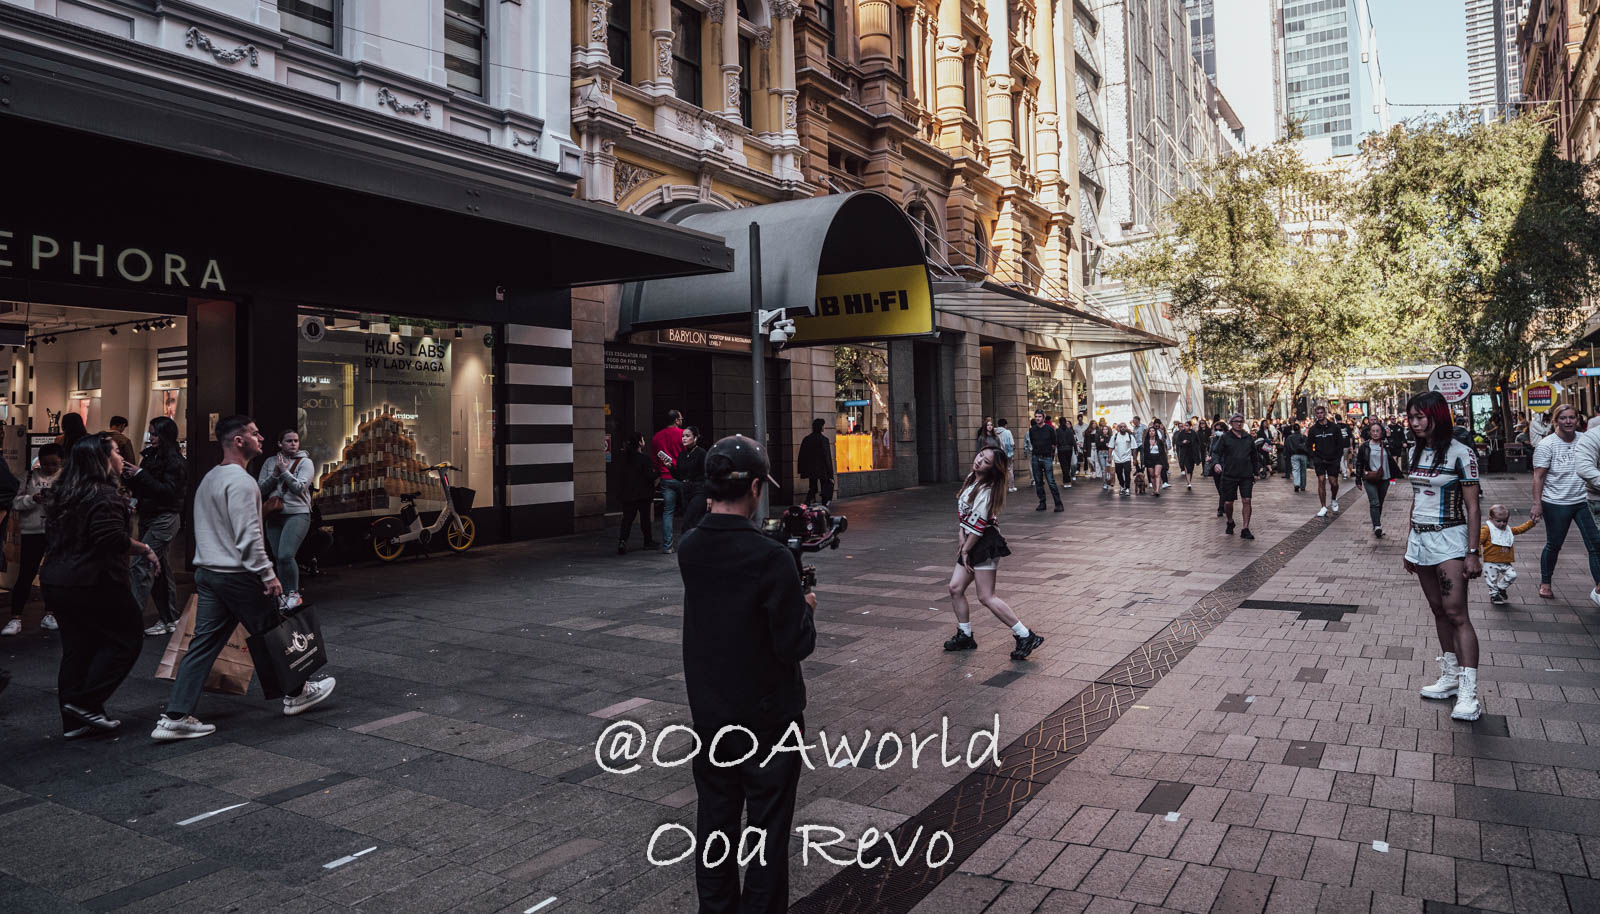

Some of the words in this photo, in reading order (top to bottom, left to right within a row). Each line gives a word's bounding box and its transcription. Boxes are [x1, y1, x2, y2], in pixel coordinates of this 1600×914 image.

[0, 231, 226, 291] EPHORA
[669, 328, 707, 345] BABYLON
[365, 340, 405, 356] HAUS
[409, 343, 445, 359] LABS
[365, 358, 380, 369] BY
[384, 359, 412, 370] LADY
[415, 360, 445, 373] GAGA
[1437, 370, 1462, 380] UGG
[1467, 448, 1478, 478] SPEED
